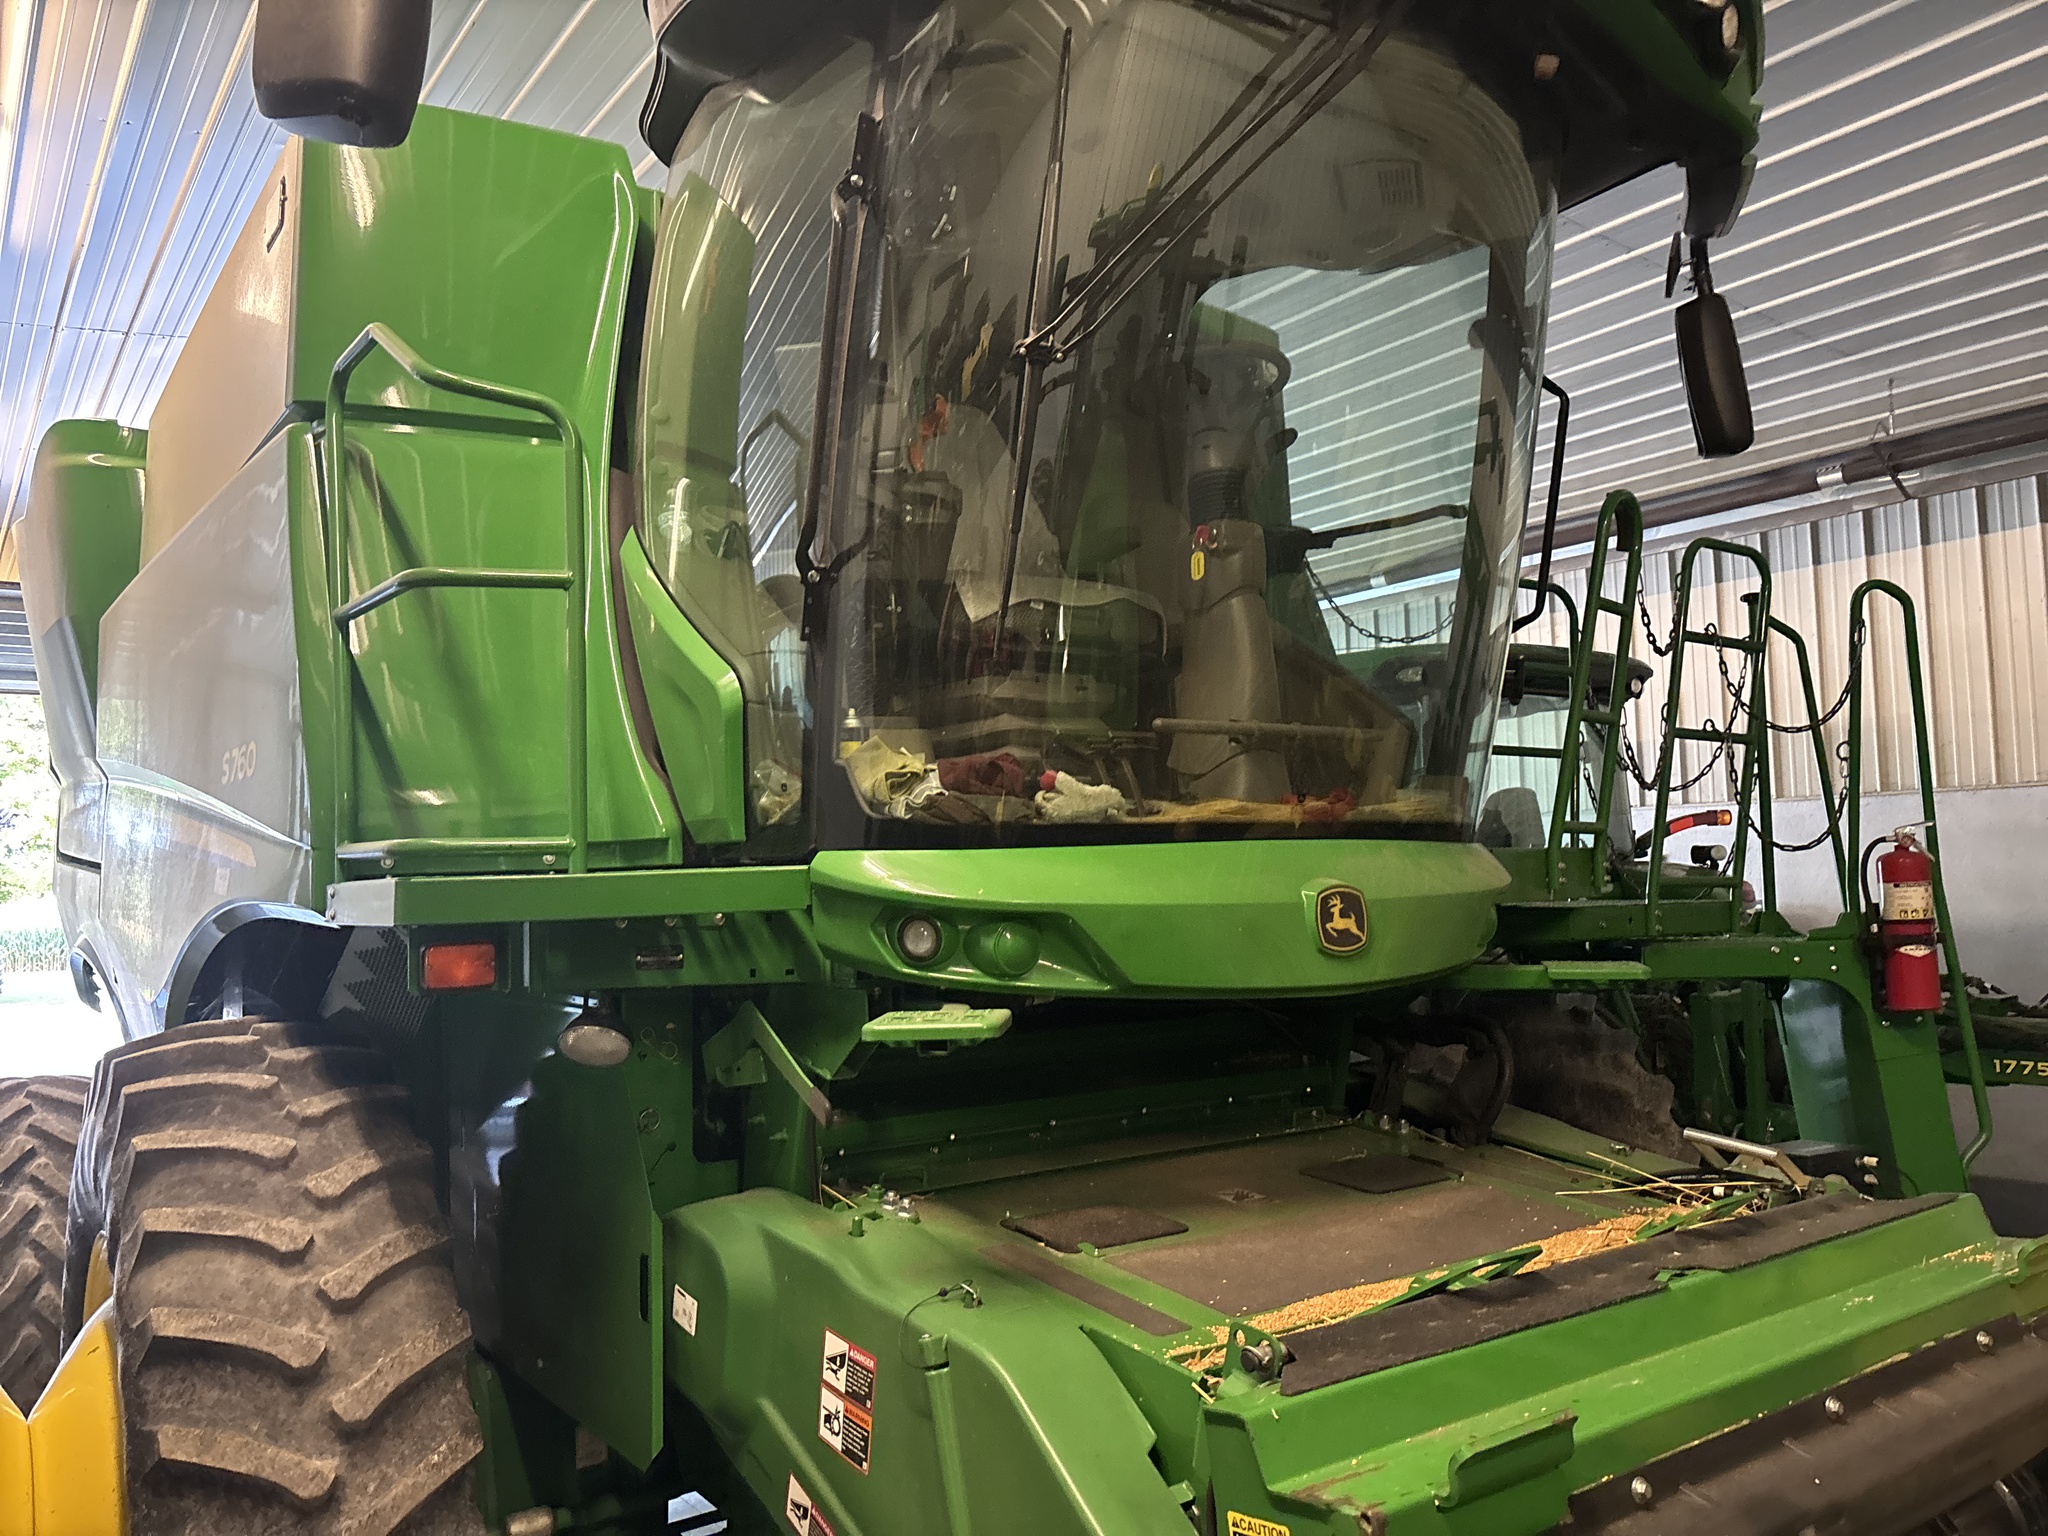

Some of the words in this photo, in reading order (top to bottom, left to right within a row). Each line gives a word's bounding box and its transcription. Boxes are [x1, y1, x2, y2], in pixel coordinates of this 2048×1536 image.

[221, 740, 257, 785] S760
[1993, 1059, 2048, 1077] 1775
[853, 1349, 875, 1370] DANGER
[1239, 1518, 1287, 1536] CAUTION
